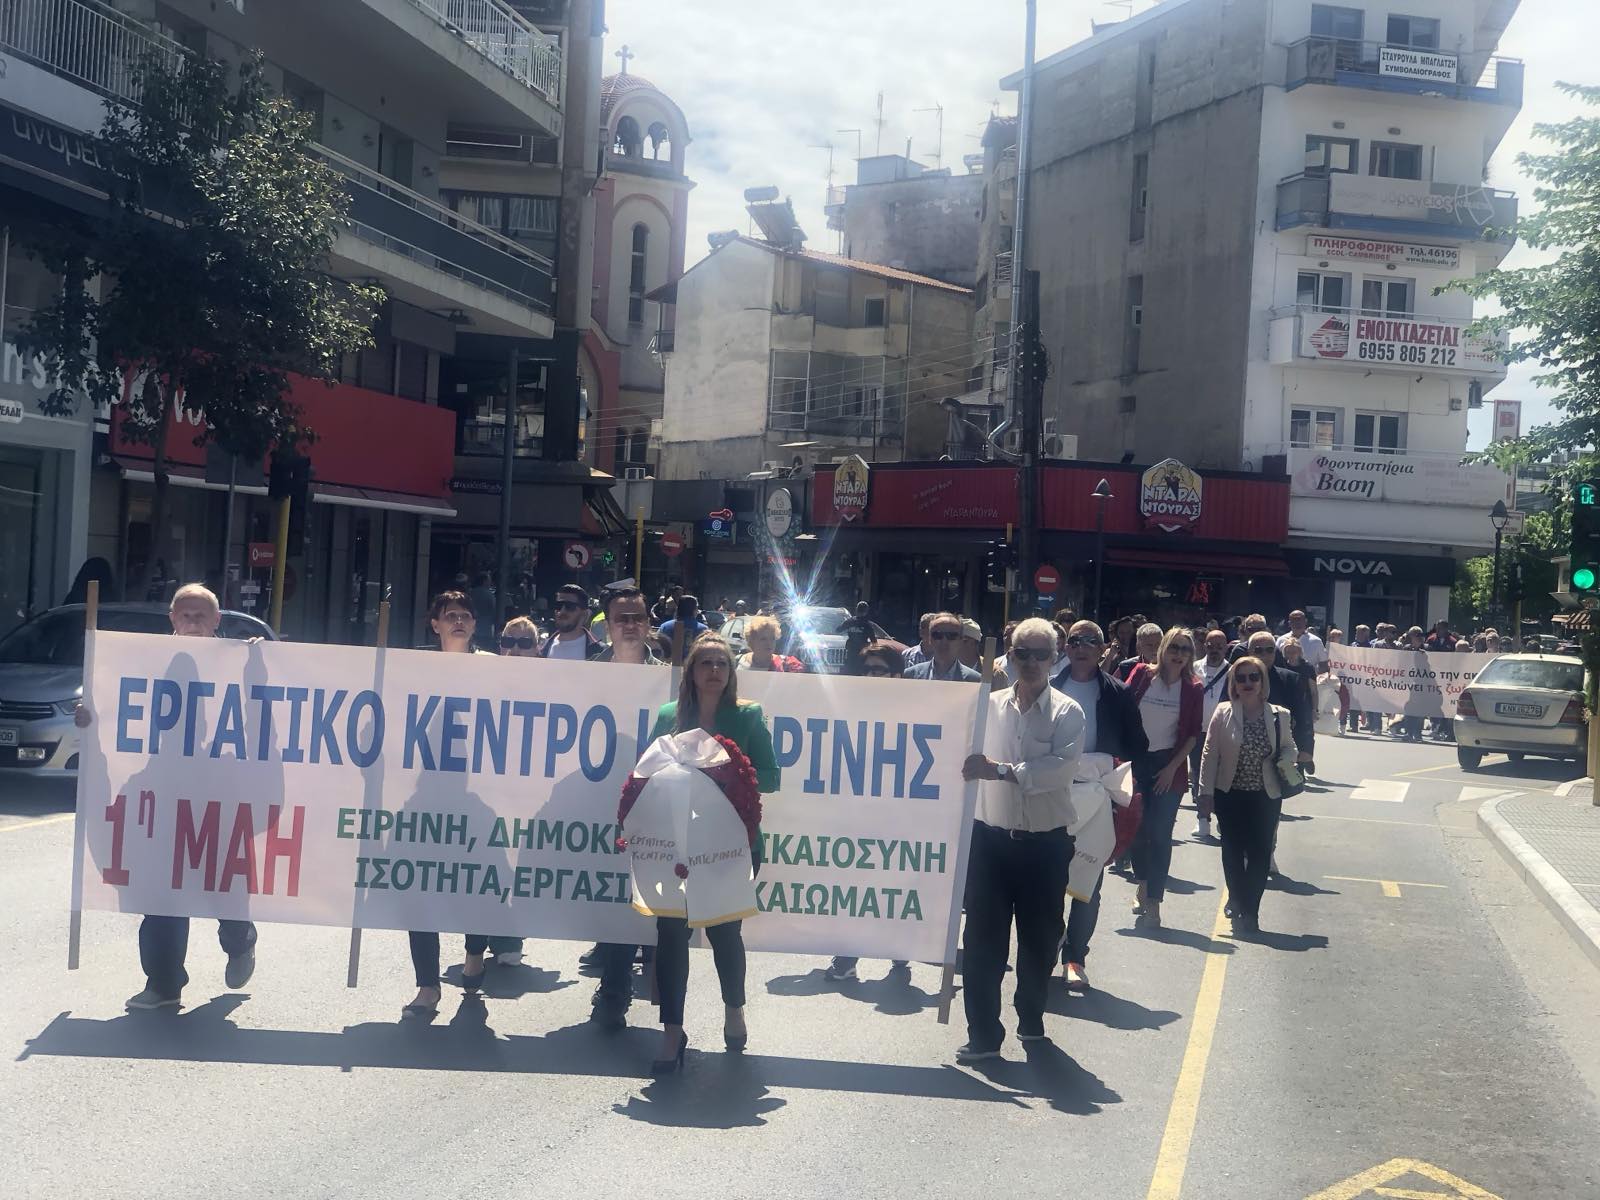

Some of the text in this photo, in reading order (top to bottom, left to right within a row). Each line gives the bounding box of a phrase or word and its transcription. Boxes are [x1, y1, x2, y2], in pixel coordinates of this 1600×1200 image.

[1382, 52, 1417, 64] ΣΤΑΥΡΟΥΛΑ
[1314, 238, 1404, 255] ΠΛΗΡΟΦΟΡΙΚΗ
[1356, 319, 1460, 347] ΕΝΟΙΚΙΑΖΕΤΑΙ
[1359, 341, 1395, 361] 6955
[1400, 347, 1426, 364] 805
[1430, 348, 1456, 366] 212
[1143, 485, 1200, 502] ΝΤΑΡΑ
[1143, 502, 1200, 515] ΝΤΟΥΡΑΣ
[1314, 558, 1392, 576] NOVA
[1350, 663, 1406, 678] αντέχουμε
[1409, 667, 1436, 679] άλλο
[1440, 671, 1459, 682] την
[1427, 685, 1442, 694] τις
[116, 677, 386, 768] ΕΡΓΑΤΙΚΟ
[403, 693, 617, 783] ΚΕΝΤΡΟ
[171, 799, 305, 897] ΜΑΗ
[337, 808, 947, 873] ΕΙΡΗΝΗ, ΔΗΜΟΚ ΙΚΑΙΟΣΥΝΗ
[755, 881, 923, 921] ΚΑΙΩΜΑΤΑ
